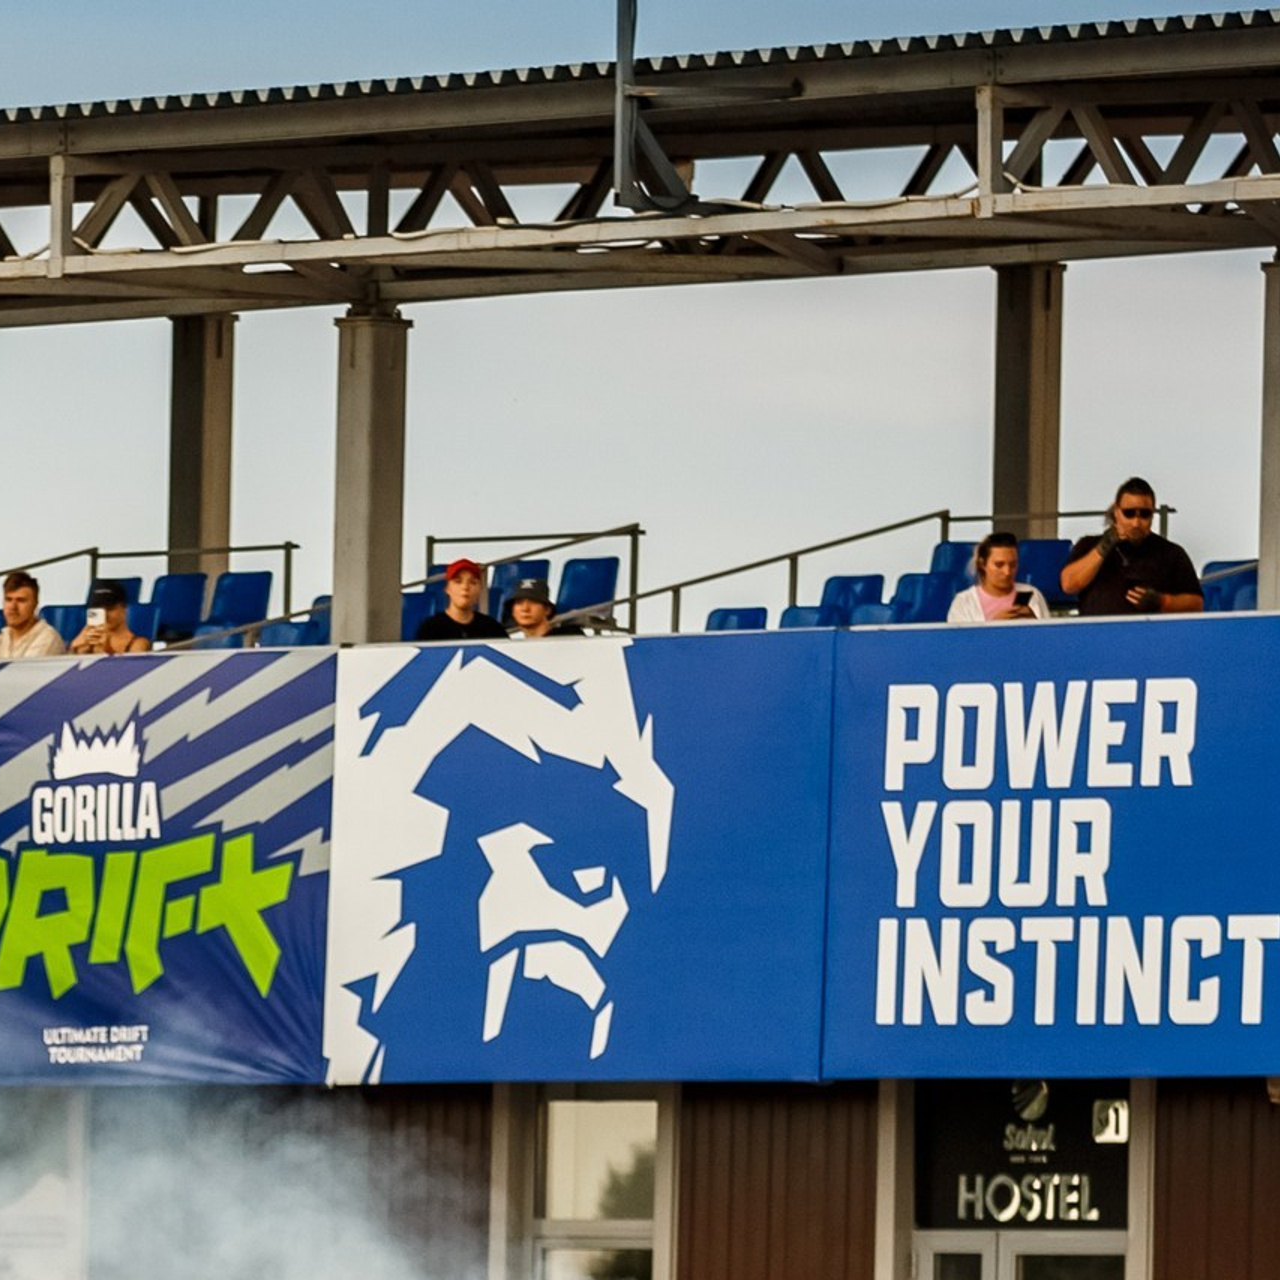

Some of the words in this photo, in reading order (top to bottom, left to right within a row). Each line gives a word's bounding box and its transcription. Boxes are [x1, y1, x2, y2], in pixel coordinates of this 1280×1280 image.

[884, 677, 1198, 791] POWER
[32, 781, 161, 844] GORILLA
[881, 797, 1112, 908] YOUR
[875, 914, 1280, 1026] INSTINCT
[43, 1025, 108, 1045] ULTIMATE
[110, 1024, 149, 1043] DRIFT
[47, 1044, 144, 1064] TOURNAMENT
[957, 1173, 1100, 1223] HOSTEL
